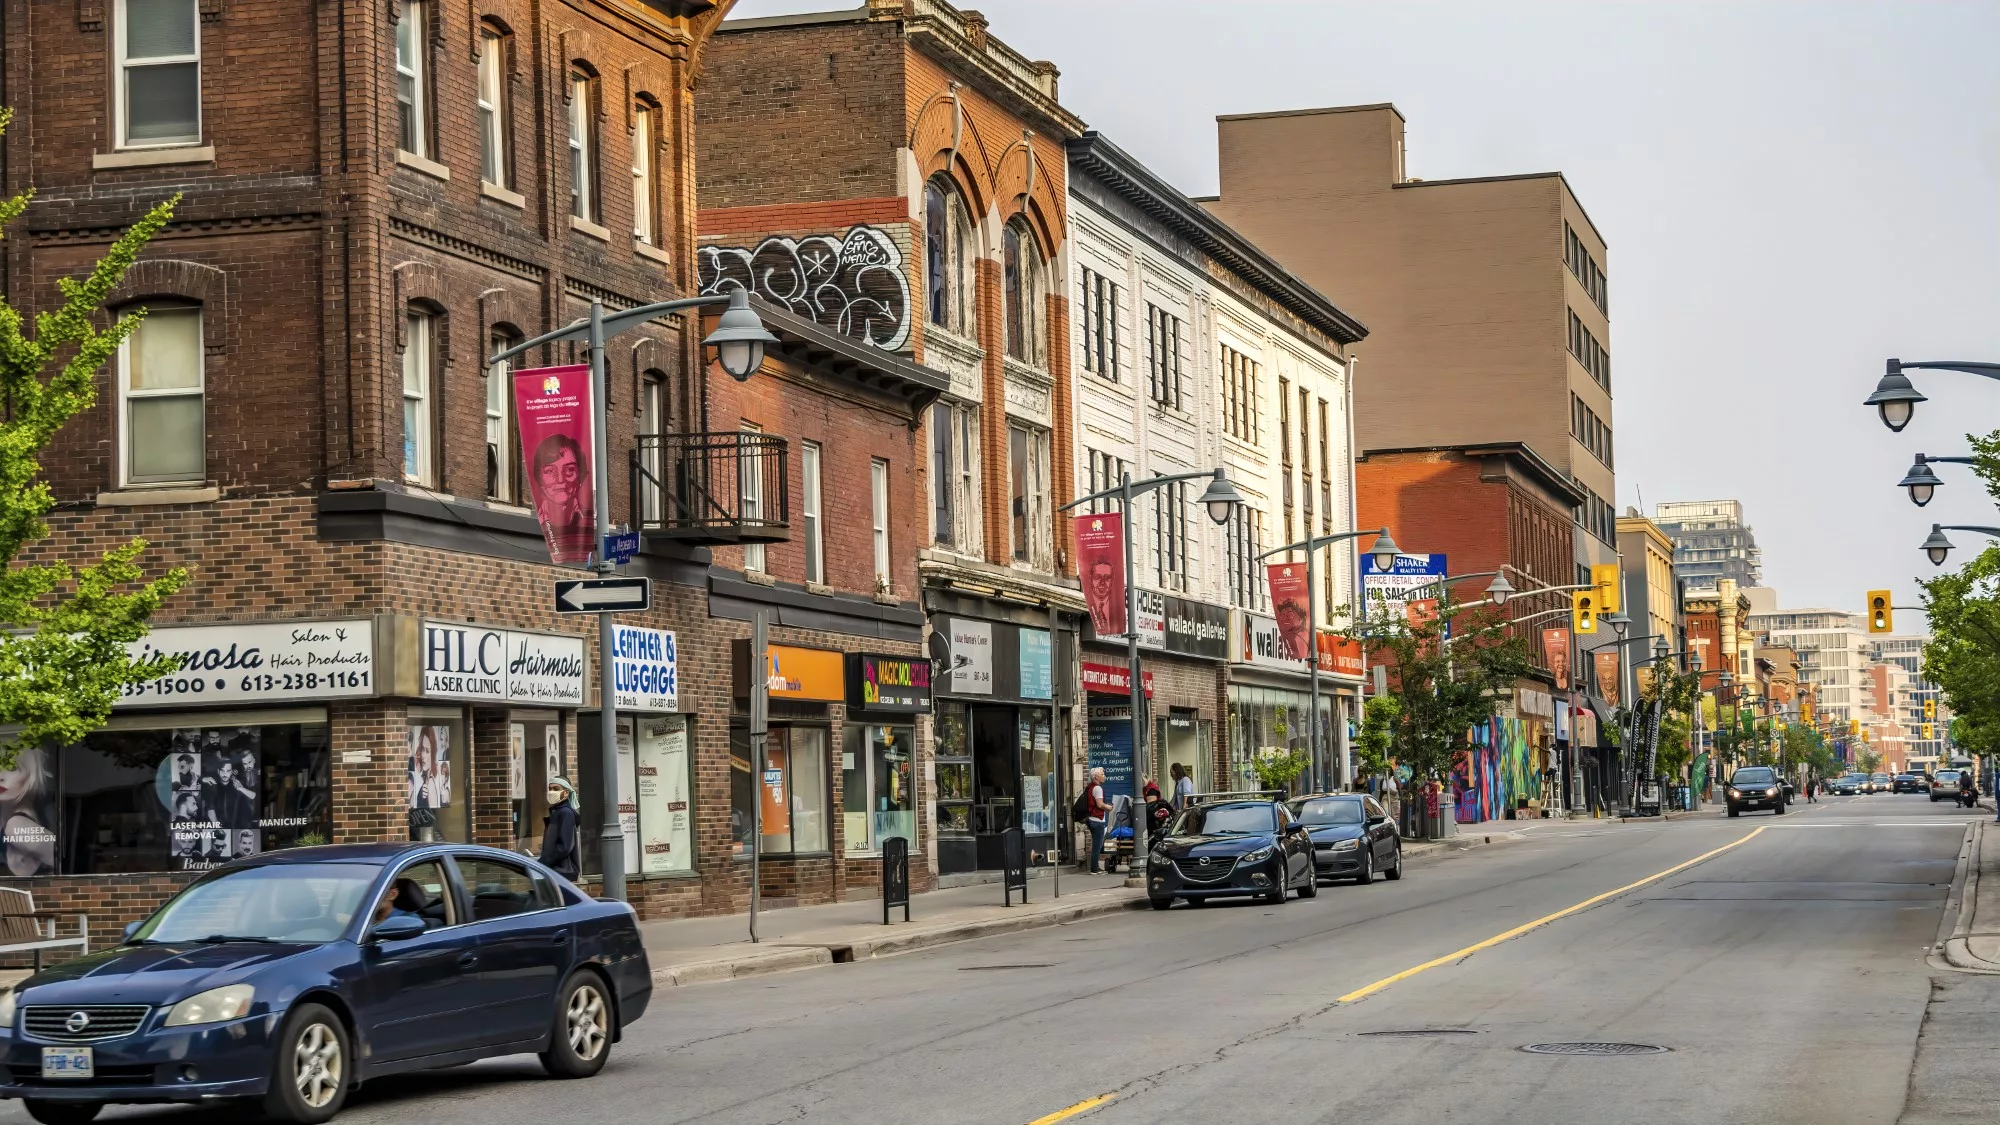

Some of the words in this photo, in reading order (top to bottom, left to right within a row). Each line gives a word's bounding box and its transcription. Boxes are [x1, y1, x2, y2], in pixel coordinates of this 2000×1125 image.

[1365, 576, 1387, 585] OFFICE
[1392, 576, 1413, 584] RETAIL
[1136, 590, 1163, 616] HOUSE
[291, 628, 331, 645] Salon
[335, 627, 348, 642] &
[1168, 615, 1196, 636] wallack
[1196, 619, 1226, 641] galleries
[425, 627, 501, 677] HLC
[510, 636, 582, 678] Hairmosa
[612, 627, 663, 662] LEATHER
[665, 634, 676, 663] &
[270, 653, 303, 669] Hair
[307, 650, 370, 668] Products
[240, 670, 369, 692] 613-238-1161
[615, 662, 675, 695] LUGGAGE
[878, 660, 899, 685] MAGIC
[899, 662, 929, 688] MOLECULE
[425, 676, 464, 693] LASER
[466, 677, 502, 694] CLINIC
[510, 681, 529, 698] Salon
[537, 683, 553, 699] Hair
[553, 683, 580, 701] Products
[14, 826, 46, 835] UNISEX
[170, 822, 197, 830] LASER
[199, 821, 221, 829] HAIR
[259, 817, 308, 827] MANICURE
[3, 834, 57, 843] HAIRDESIGN
[175, 831, 217, 840] REMOVAL
